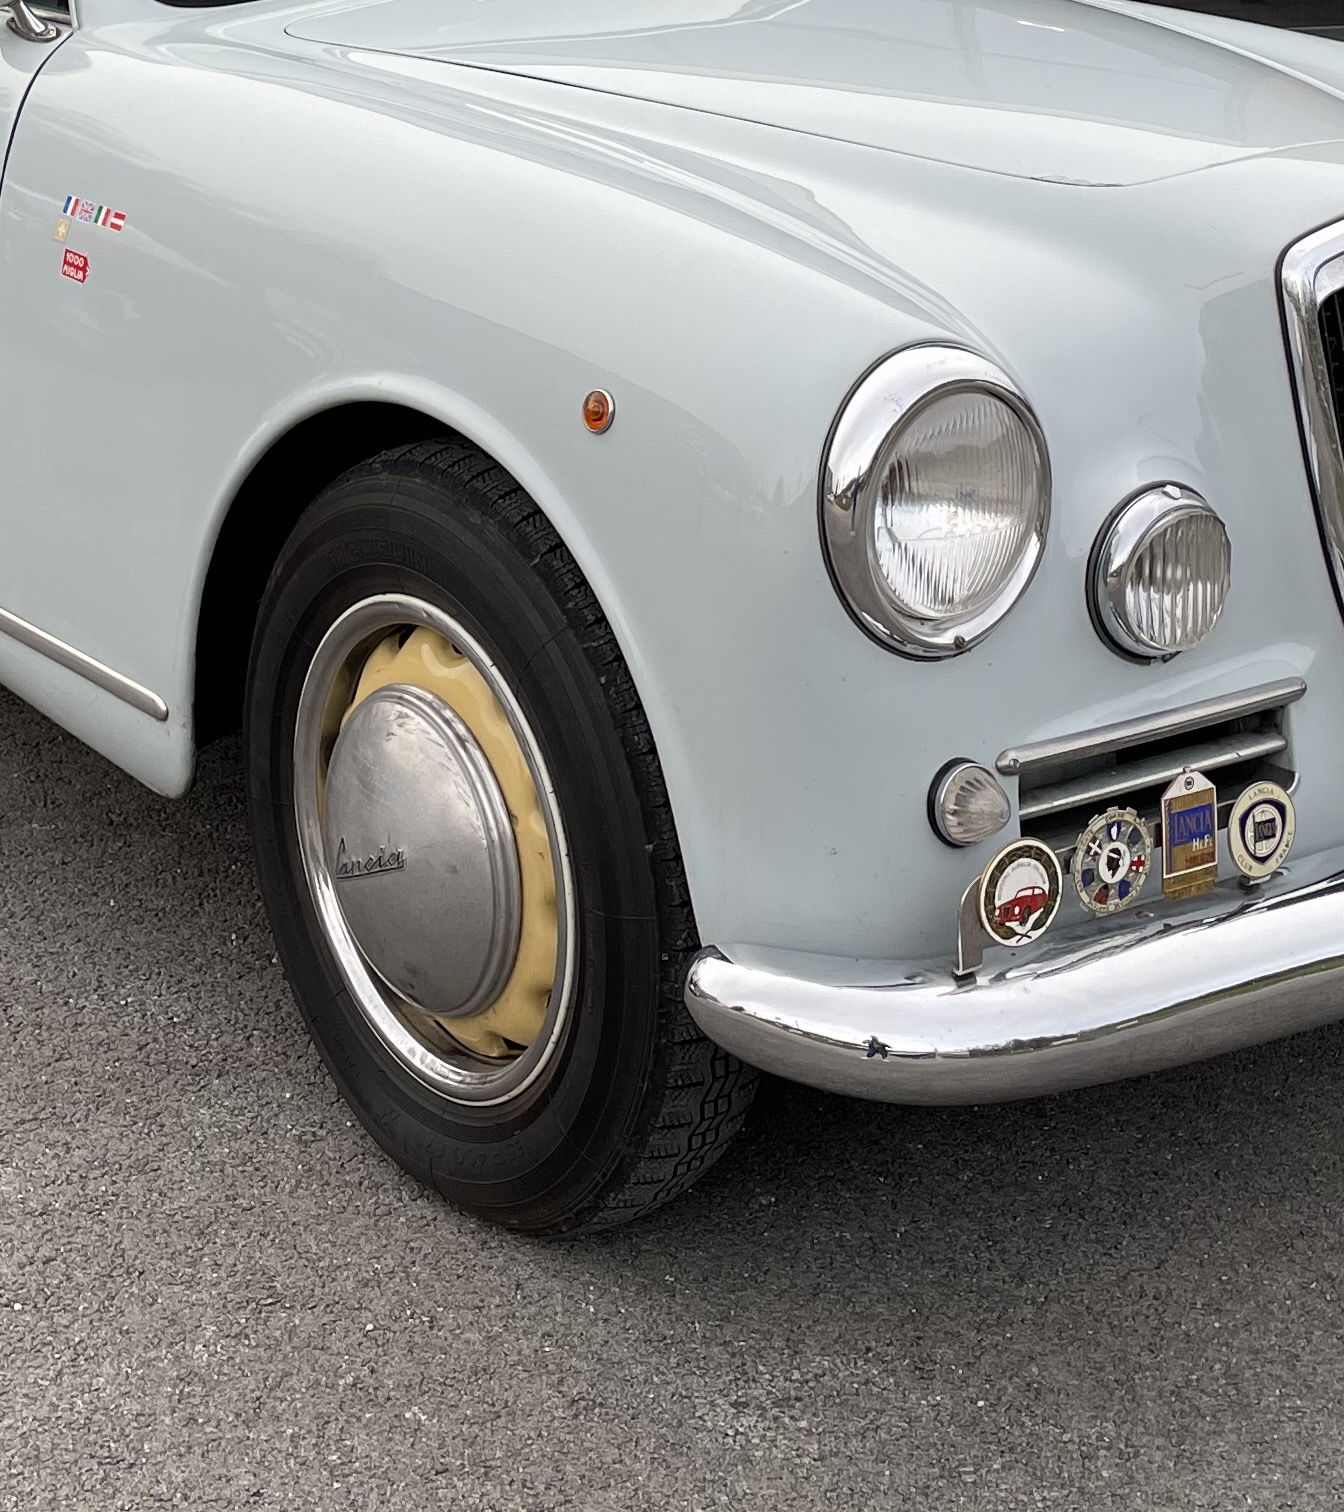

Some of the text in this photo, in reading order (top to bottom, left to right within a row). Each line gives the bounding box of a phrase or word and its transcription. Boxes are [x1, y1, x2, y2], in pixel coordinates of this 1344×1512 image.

[1247, 787, 1274, 802] LANCIA
[1173, 808, 1213, 846] LANCIA
[335, 836, 406, 880] Lancia
[1237, 854, 1253, 873] CLUB
